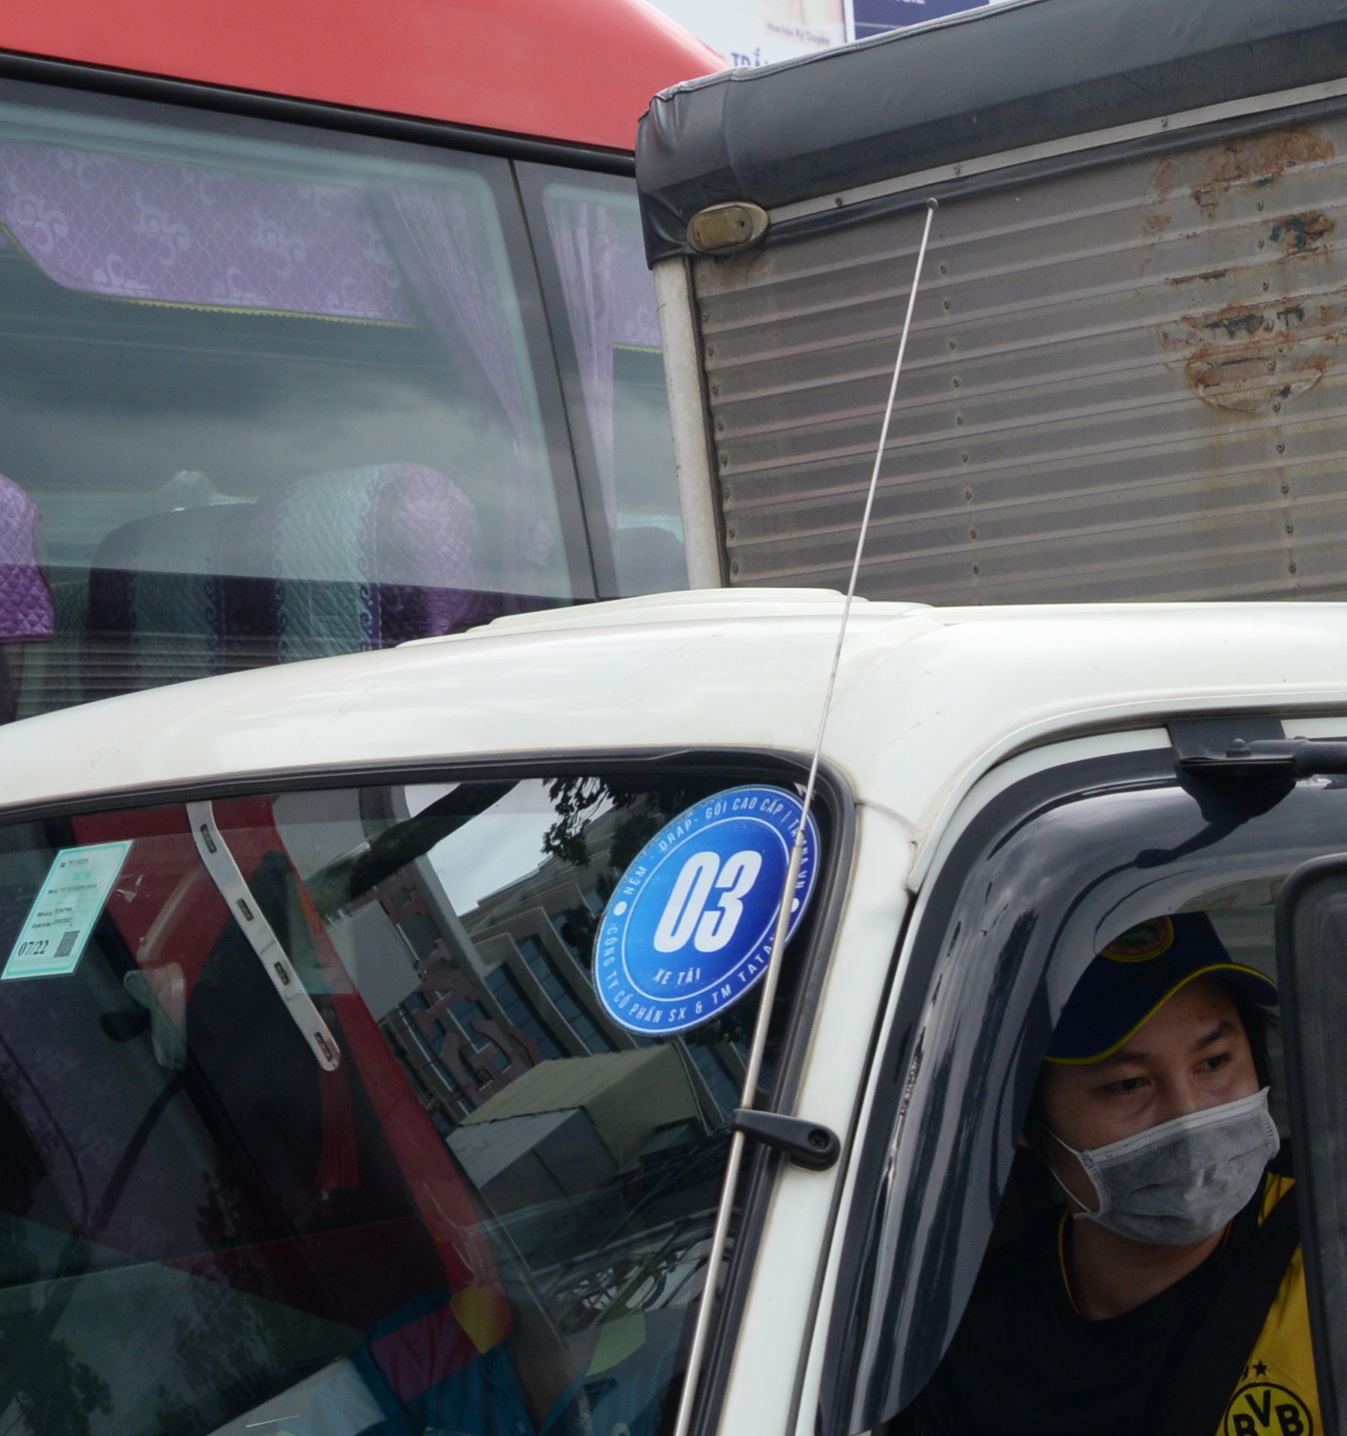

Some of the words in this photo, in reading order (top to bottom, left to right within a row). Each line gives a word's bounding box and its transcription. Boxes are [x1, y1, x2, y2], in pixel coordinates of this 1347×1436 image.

[732, 796, 758, 811] CAO
[653, 850, 763, 954] 03
[653, 967, 673, 985] XE
[605, 969, 620, 989] TY
[668, 1006, 687, 1023] SX
[710, 984, 733, 1005] TM
